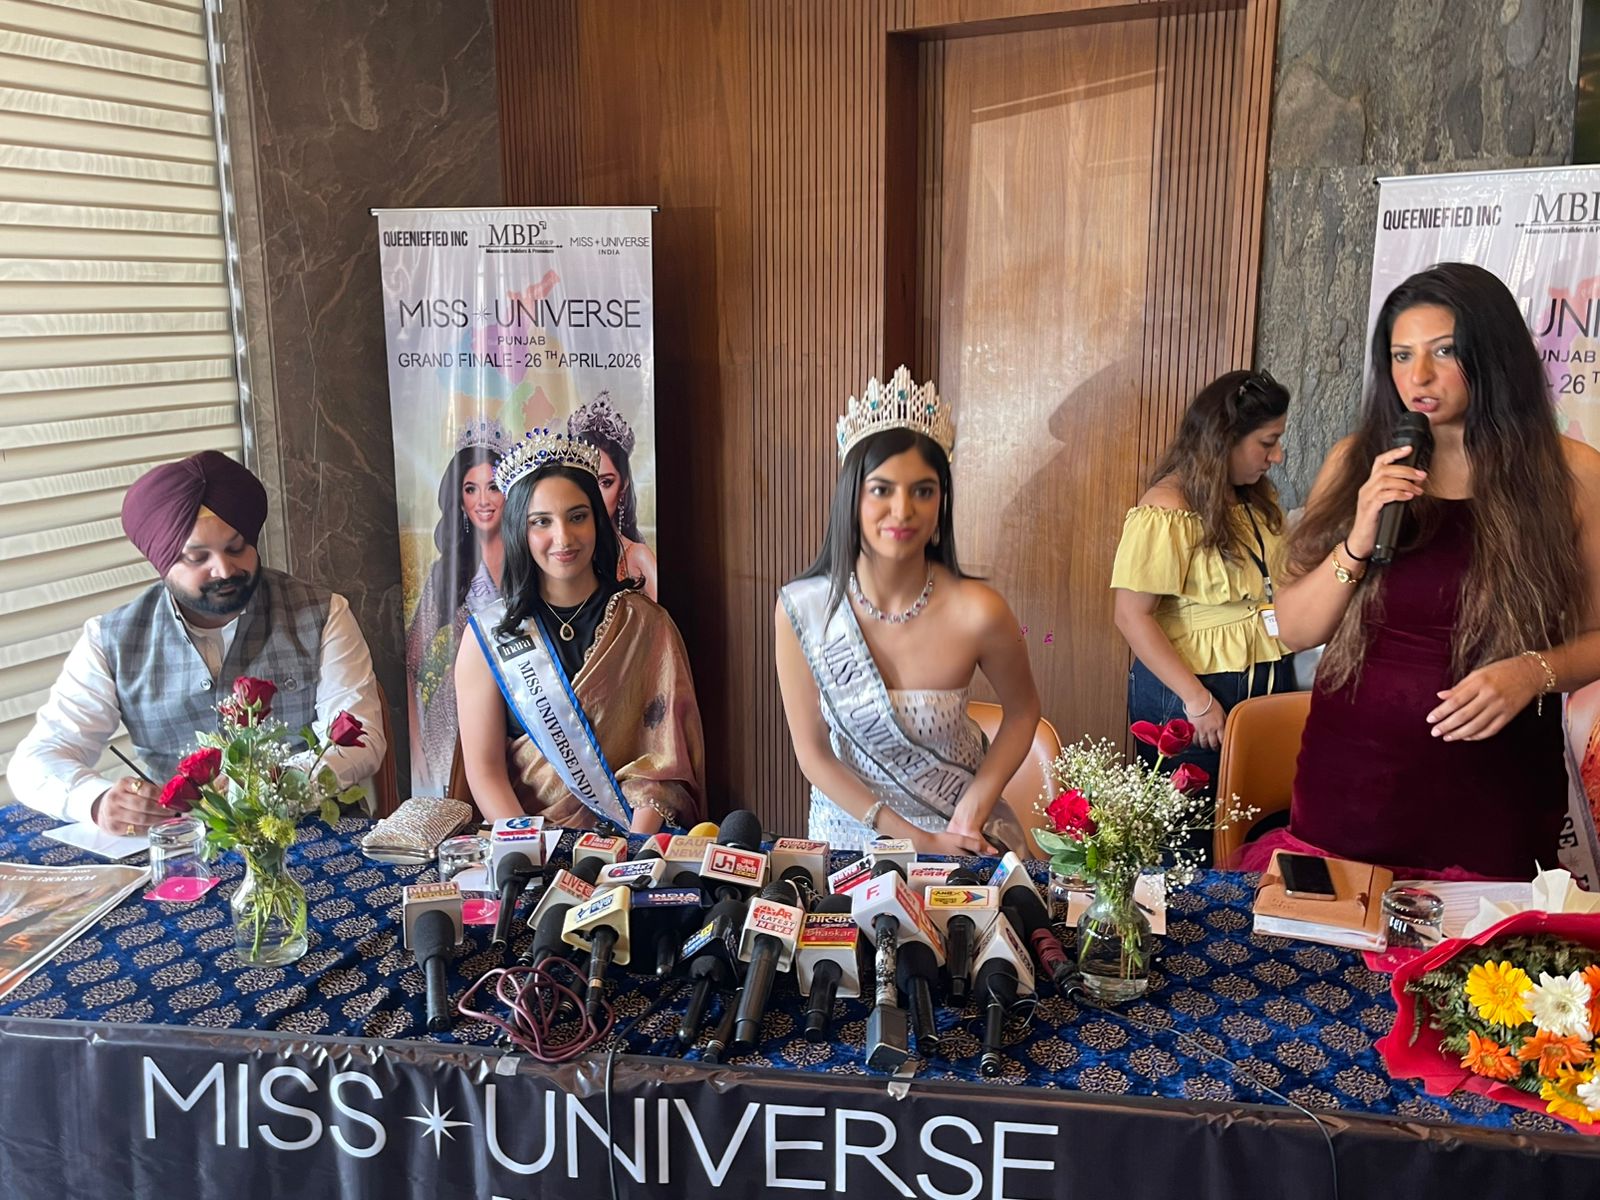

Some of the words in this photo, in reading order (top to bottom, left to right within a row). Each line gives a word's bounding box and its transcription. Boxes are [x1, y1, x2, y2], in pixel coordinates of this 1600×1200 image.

[1383, 206, 1473, 231] QUEENIEFIED
[1476, 205, 1502, 227] INC
[383, 230, 449, 247] QUEENIEFIED
[450, 230, 469, 246] INC
[488, 223, 541, 246] MBP
[569, 236, 594, 248] MISS
[601, 236, 650, 248] UNIVERSE
[400, 299, 469, 328] MISS
[495, 299, 641, 328] UNIVERSE
[497, 335, 546, 346] PUNJAB
[398, 353, 454, 368] GRAND
[458, 353, 513, 368] FINALE
[524, 353, 542, 368] 26
[545, 350, 559, 360] TH
[558, 352, 642, 370] APRIL,2026
[1541, 349, 1596, 363] UNJAB
[1559, 373, 1586, 395] 26
[823, 633, 863, 687] MISS
[517, 660, 543, 696] MISS
[535, 696, 580, 769] UNIVERSE
[561, 871, 587, 894] LIVE
[757, 921, 793, 935] NEWS
[760, 914, 797, 928] LATEST
[143, 1056, 387, 1158] MISS
[485, 1084, 1059, 1200] UNIVERSE
